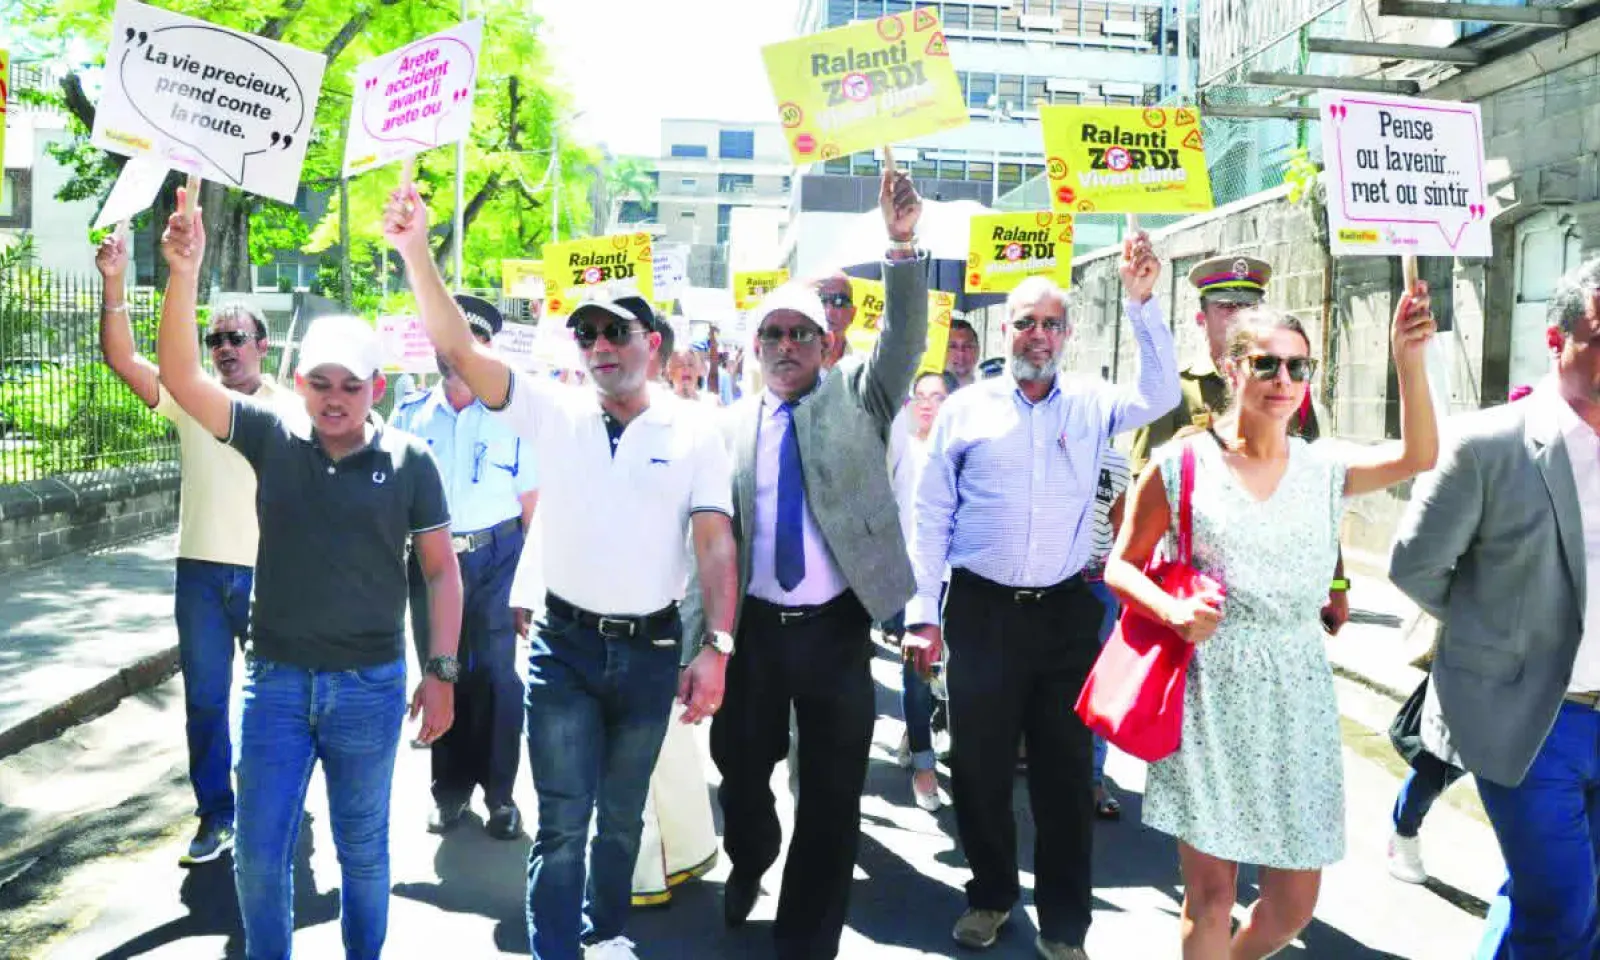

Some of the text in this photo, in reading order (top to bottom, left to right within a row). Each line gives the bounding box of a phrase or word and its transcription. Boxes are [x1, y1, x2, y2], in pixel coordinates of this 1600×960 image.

[144, 43, 291, 103] La vie precieux,
[398, 48, 440, 74] Arete
[811, 40, 907, 76] Ralanti
[385, 60, 450, 96] accident
[155, 76, 271, 120] prend conte
[388, 78, 441, 112] avant li
[170, 102, 245, 139] la route.
[381, 99, 442, 132] arete ou
[1378, 111, 1434, 141] Pense
[1081, 124, 1167, 148] Ralanti
[1356, 145, 1460, 175] ou lavenir...
[1351, 177, 1469, 207] met ou sintir
[992, 226, 1050, 242] Ralanti
[569, 249, 628, 267] Ralanti
[746, 277, 778, 286] Ralanti
